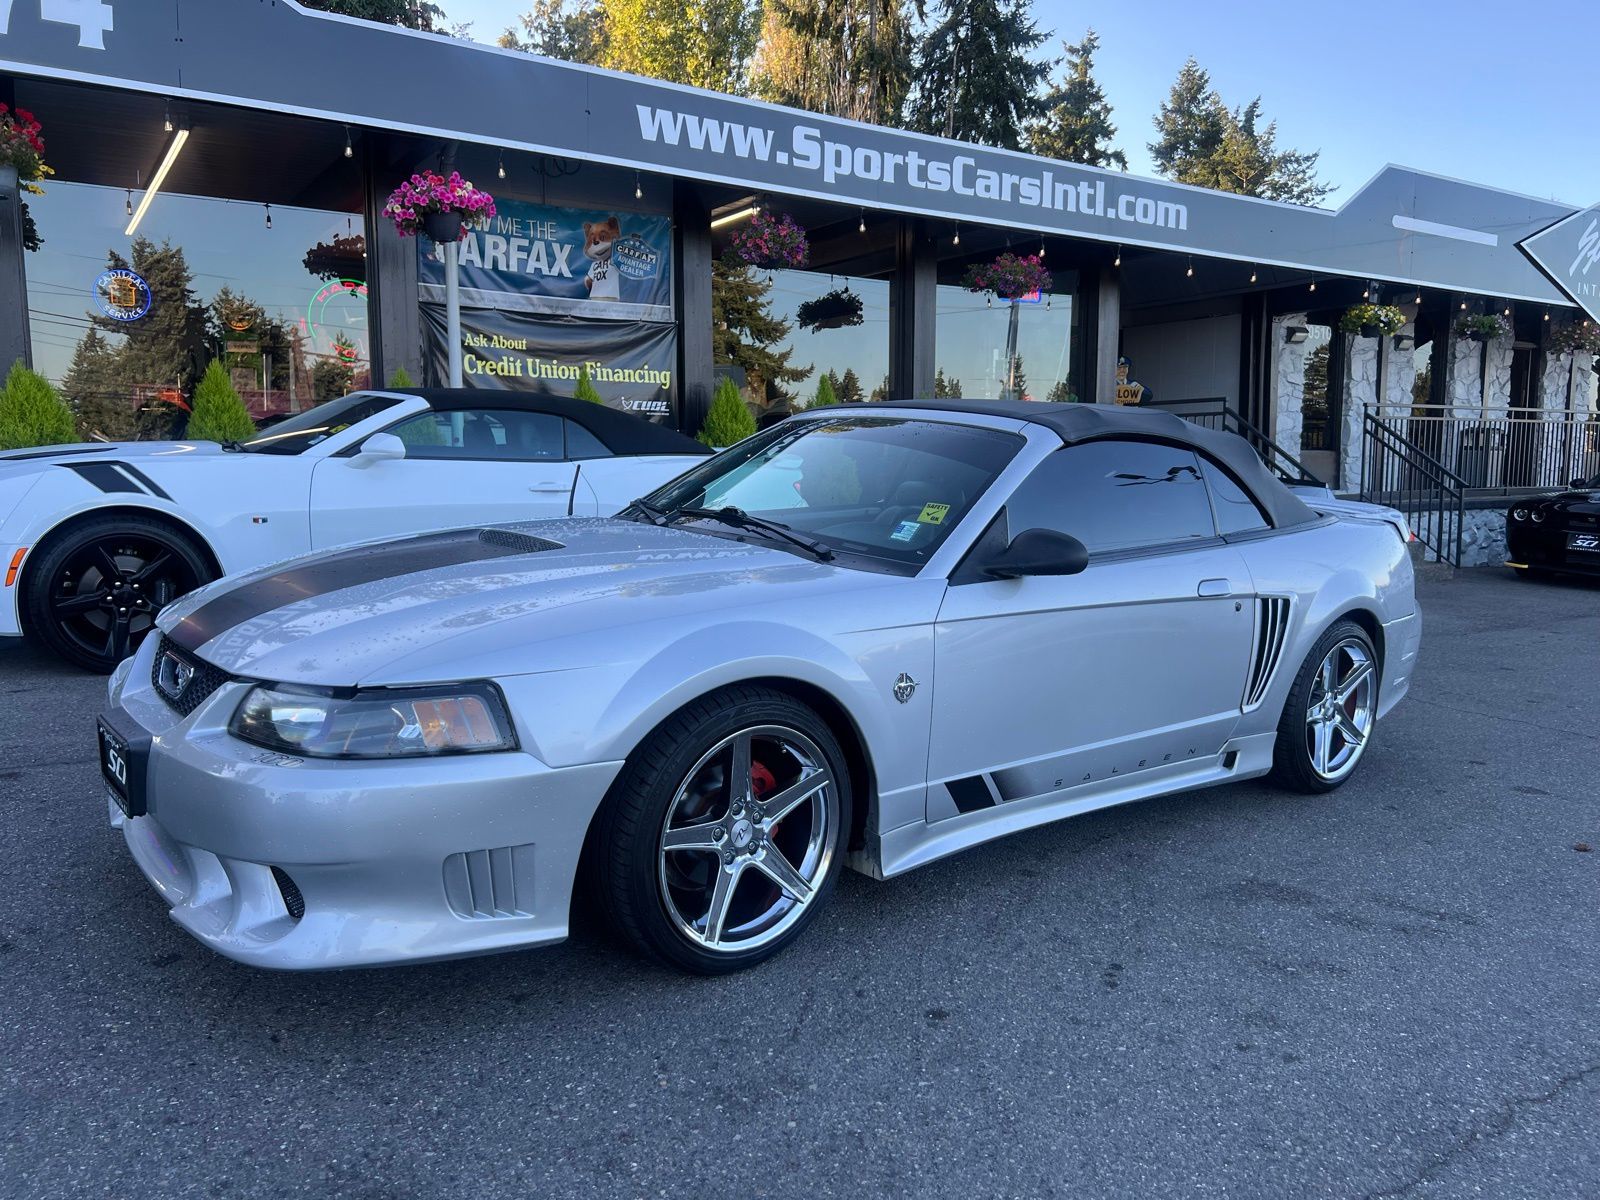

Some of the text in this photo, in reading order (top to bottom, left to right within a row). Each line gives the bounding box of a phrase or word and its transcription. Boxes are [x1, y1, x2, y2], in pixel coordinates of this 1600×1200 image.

[635, 104, 1188, 230] www.SportsCarsIntl.com
[497, 216, 523, 237] ME
[526, 220, 557, 241] THE
[617, 245, 657, 264] CARFAX
[592, 260, 609, 271] CAR
[618, 255, 653, 272] ADVANTAGE
[620, 264, 644, 277] DEALER
[98, 270, 147, 291] CADILLAC
[593, 270, 608, 281] FOX
[1577, 282, 1600, 297] INT
[104, 304, 144, 320] SERVICE
[464, 333, 527, 350] Ask About
[463, 354, 671, 390] Credit Union Financing
[1117, 388, 1140, 399] LOW
[926, 503, 949, 511] SAFETY
[1054, 747, 1197, 787] SALEEN
